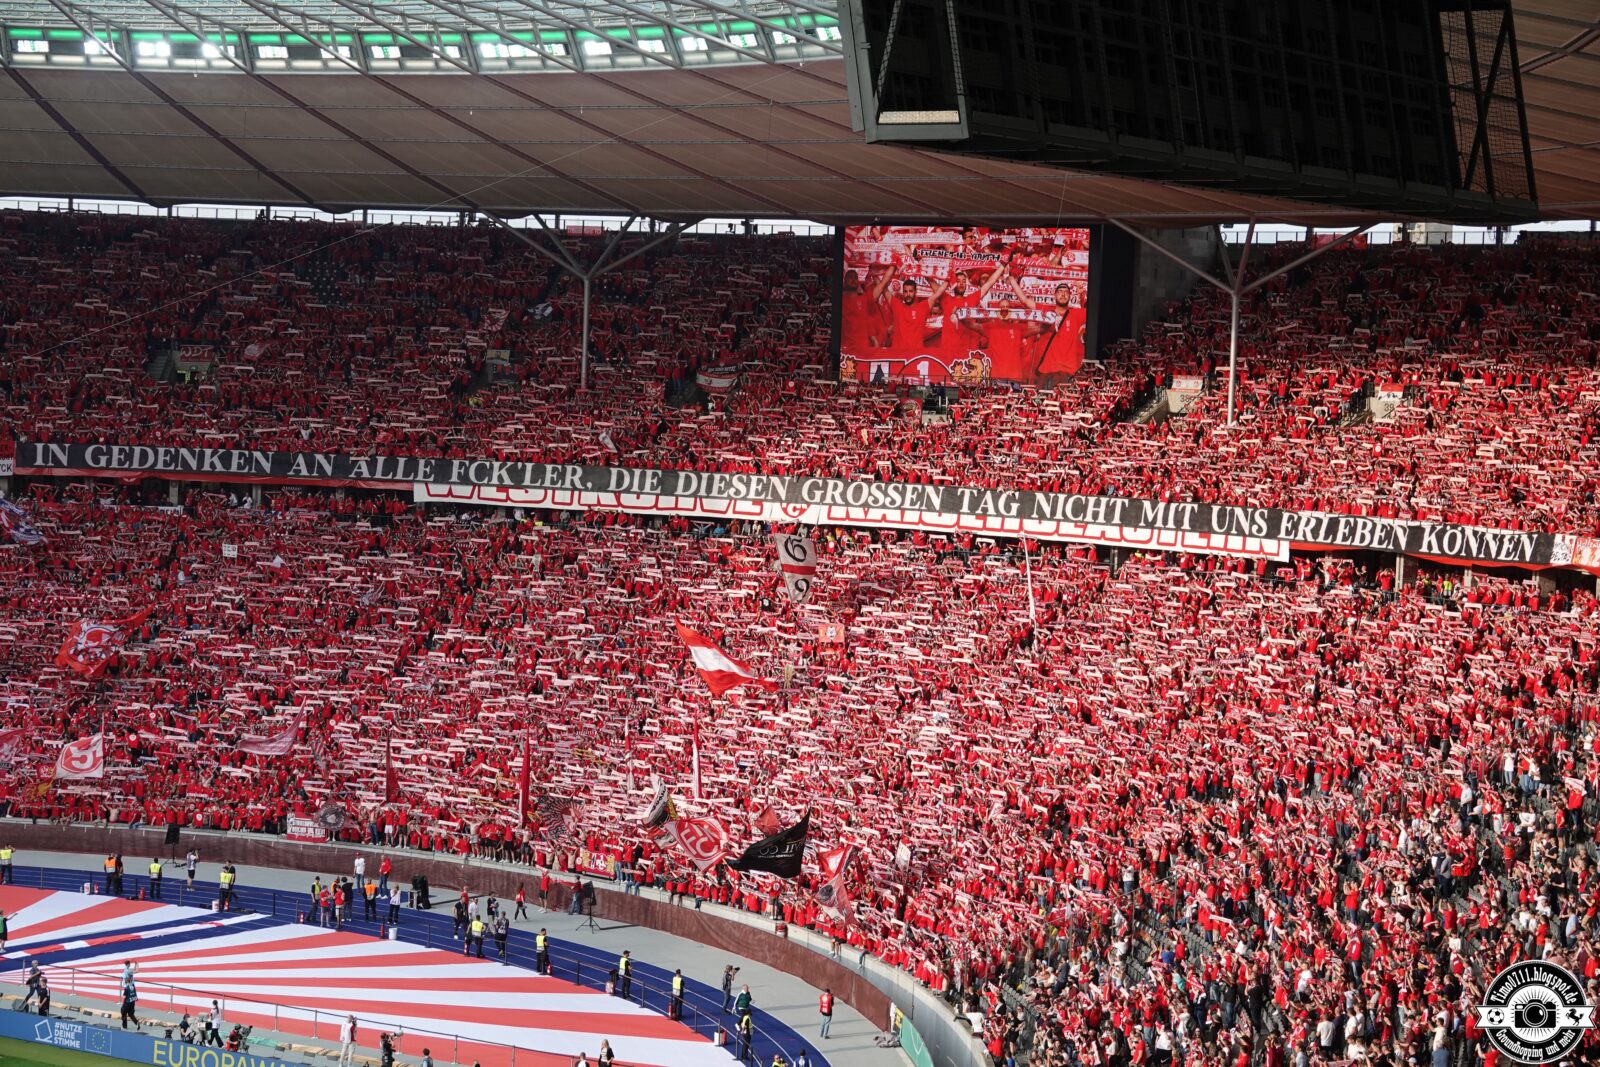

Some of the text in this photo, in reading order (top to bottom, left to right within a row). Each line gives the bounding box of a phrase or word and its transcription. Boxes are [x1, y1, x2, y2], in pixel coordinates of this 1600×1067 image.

[33, 443, 71, 467] IN
[84, 444, 272, 474] GEDENKEN
[287, 453, 336, 477] AN
[348, 455, 435, 483] ALLE
[449, 459, 593, 490] FCK'LER,
[607, 467, 662, 494] DIE
[674, 471, 792, 501] DIESEN
[801, 478, 945, 512] GROSSEN
[957, 487, 1020, 517] TAG
[1031, 492, 1129, 525] NICHT
[1139, 500, 1198, 531] MIT
[1211, 504, 1268, 537] UNS
[1277, 511, 1410, 551] ERLEBEN
[1419, 523, 1538, 562] KÖNNEN
[54, 1021, 82, 1034] #NUTZE
[54, 1030, 75, 1040] DEINE
[54, 1038, 80, 1049] STIMME
